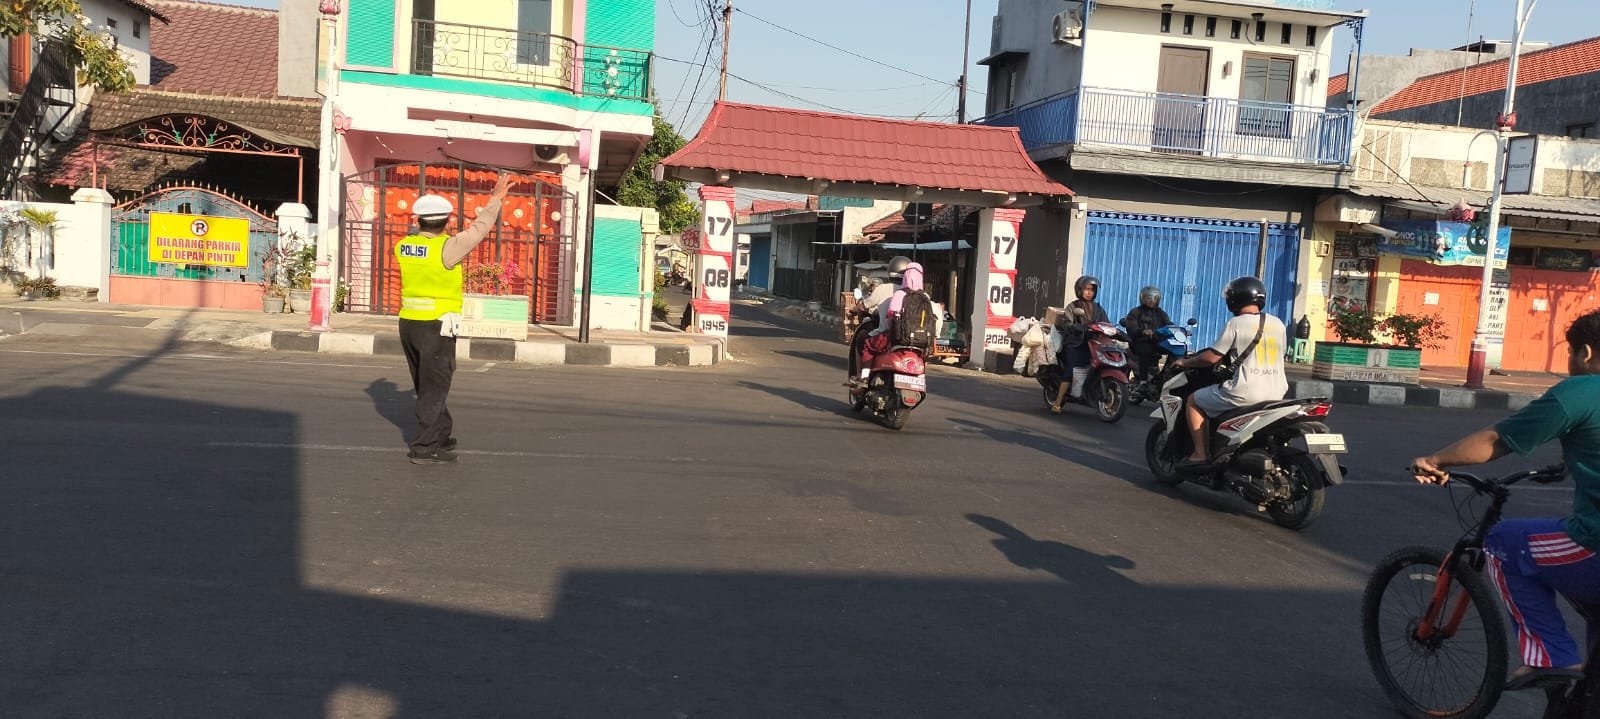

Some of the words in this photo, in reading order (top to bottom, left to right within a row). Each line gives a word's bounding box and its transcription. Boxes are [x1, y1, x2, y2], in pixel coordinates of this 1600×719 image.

[707, 216, 732, 237] 17
[156, 237, 204, 249] DILARANG
[205, 240, 241, 252] PARKIR
[400, 244, 427, 257] POLISI
[993, 236, 1015, 255] 17
[162, 250, 172, 259] DI
[174, 250, 205, 261] DEPAN
[207, 252, 235, 263] PINTU
[704, 268, 729, 288] 08
[989, 285, 1012, 304] 08
[701, 319, 726, 332] 1945
[985, 333, 1010, 345] 2026
